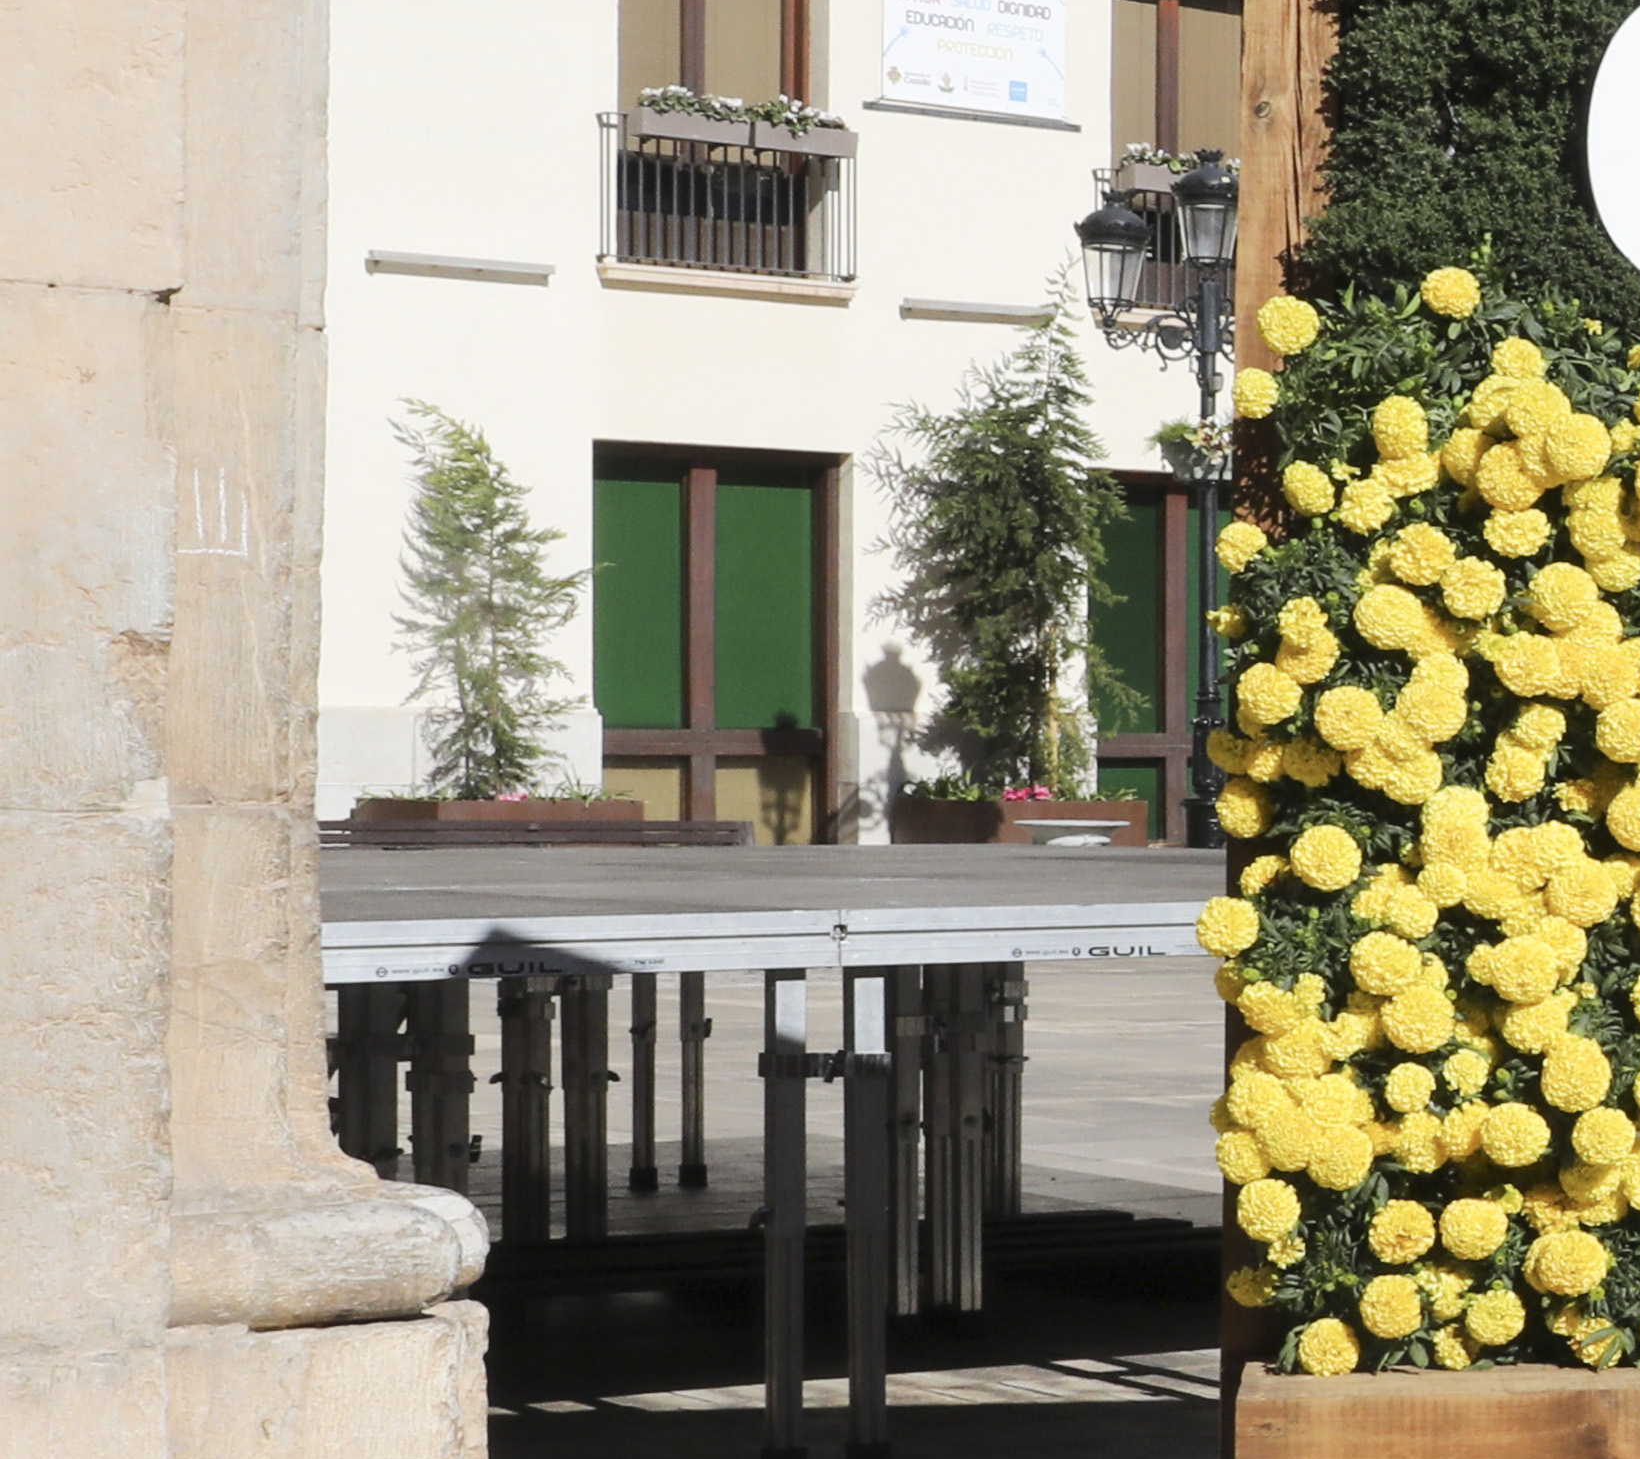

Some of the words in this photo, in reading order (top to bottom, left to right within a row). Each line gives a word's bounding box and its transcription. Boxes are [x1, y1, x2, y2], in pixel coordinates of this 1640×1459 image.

[998, 0, 1052, 21] DIGNIDAD
[905, 9, 975, 33] EDUCACIÓN
[986, 22, 1044, 43] RESPETO
[937, 37, 1014, 62] PROTECCIÓN
[1088, 945, 1166, 957] GUIL
[466, 960, 564, 975] GUIL
